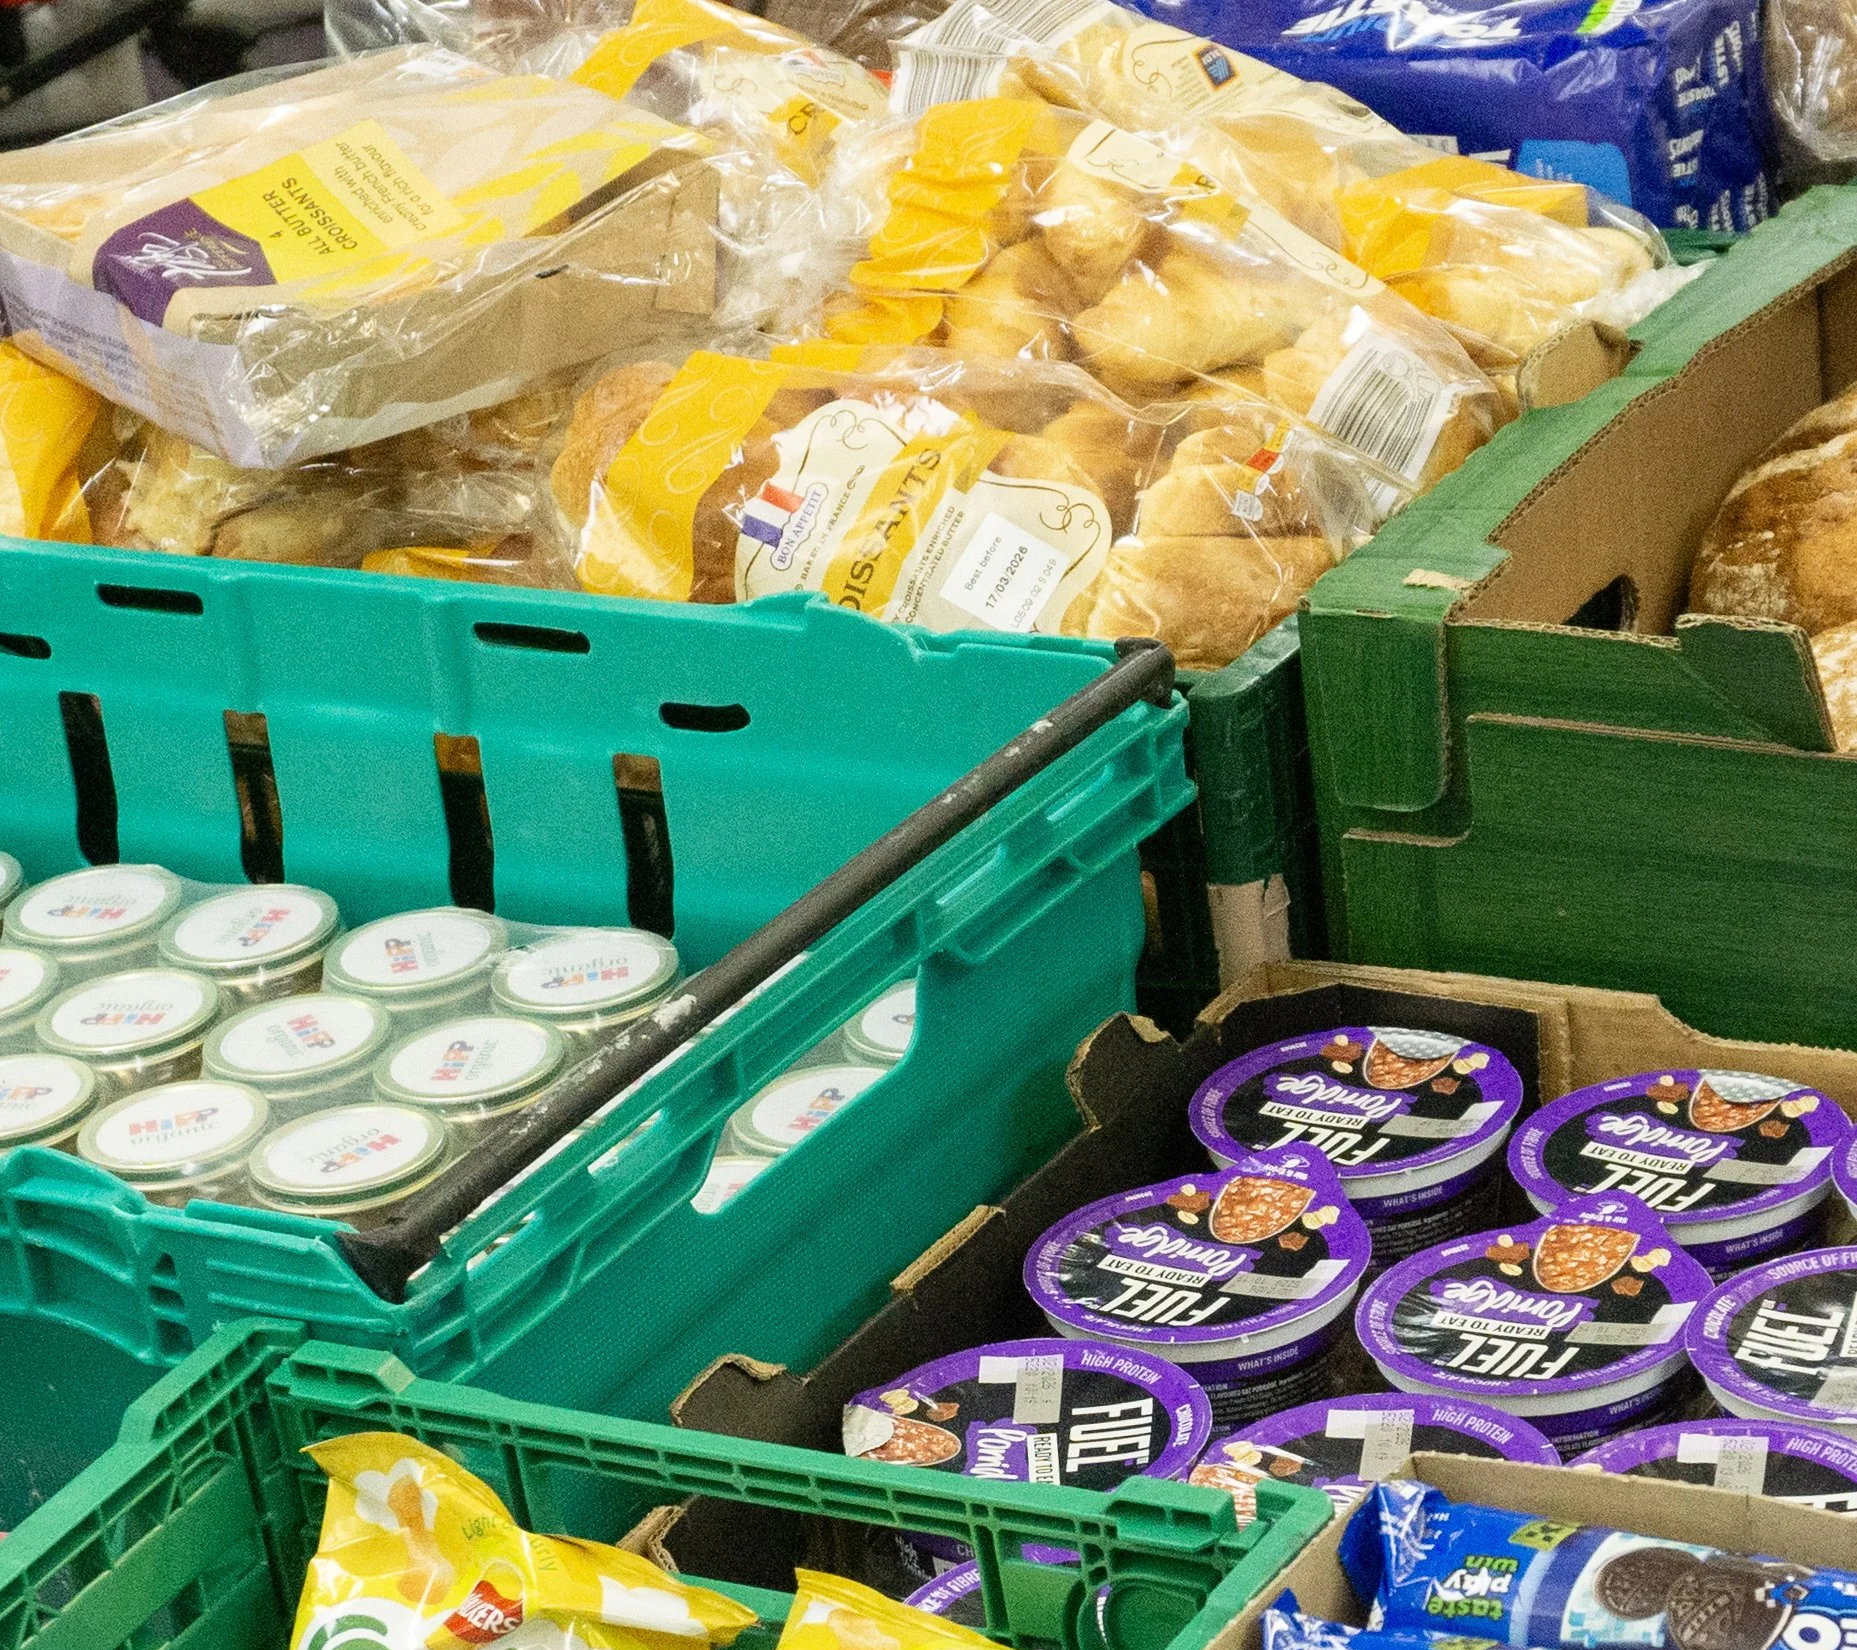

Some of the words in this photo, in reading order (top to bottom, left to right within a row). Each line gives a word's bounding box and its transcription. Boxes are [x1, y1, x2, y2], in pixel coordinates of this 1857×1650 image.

[335, 142, 368, 172] butter
[361, 143, 397, 179] flavour
[334, 165, 357, 189] with
[362, 169, 397, 205] French
[393, 176, 414, 196] rich
[261, 189, 314, 234] BUTTER
[281, 176, 359, 250] CROISSANTS
[351, 186, 393, 223] enriched
[410, 194, 422, 204] a
[390, 201, 427, 232] creamy
[268, 228, 286, 240] 4
[304, 232, 335, 256] ALL
[800, 544, 821, 582] BAKED
[827, 490, 850, 534] FRANCE
[837, 446, 942, 611] OISSANTS
[926, 505, 956, 555] ENRICHED
[777, 538, 796, 565] BON
[964, 567, 984, 592] Best
[978, 535, 1003, 570] before
[905, 546, 946, 625] CONCENTRATED
[943, 510, 965, 548] BUTTER
[984, 544, 1029, 610] 17/03/2026
[1266, 1102, 1294, 1117] EAT
[1275, 1073, 1403, 1120] Porridge
[1294, 1108, 1314, 1120] TO
[1316, 1111, 1364, 1128] READY
[1588, 1144, 1616, 1161] EAT
[1598, 1113, 1730, 1164] Porridge
[1617, 1152, 1639, 1165] TO
[1641, 1156, 1688, 1173] READY
[1382, 1191, 1418, 1208] WHAT'S
[1417, 1185, 1444, 1201] INSIDE
[1116, 1225, 1248, 1278] Porridge
[1725, 1235, 1759, 1254] WHAT'S
[1759, 1228, 1784, 1245] INSIDE
[1105, 1257, 1134, 1274] EAT
[1134, 1265, 1155, 1279] TO
[1157, 1269, 1206, 1287] READY
[1768, 1256, 1820, 1281] SOURCE
[1821, 1253, 1840, 1267] OF
[1108, 1276, 1232, 1327] FUEL
[1443, 1279, 1583, 1328] Porridge
[1439, 1312, 1469, 1327] EAT
[1471, 1318, 1494, 1331] TO
[1498, 1320, 1546, 1338] READY
[1734, 1304, 1846, 1377] FUEL
[1080, 1349, 1110, 1368] HIGH
[1109, 1357, 1162, 1386] PROTEIN
[1237, 1355, 1273, 1372] WHAT'S
[1273, 1345, 1300, 1365] INSIDE
[1447, 1332, 1580, 1380] FUEL
[1608, 1398, 1644, 1415] WHAT'S
[1065, 1397, 1154, 1473] FUEL
[1172, 1403, 1192, 1448] CHOCOLATE
[1431, 1408, 1464, 1428] HIGH
[1464, 1414, 1516, 1445] PROTEIN
[969, 1428, 1028, 1480] Porrid
[1033, 1436, 1052, 1464] READY
[1786, 1437, 1823, 1460] HIGH
[1823, 1442, 1857, 1473] PROTE
[1034, 1464, 1054, 1478] TO
[460, 1514, 497, 1541] Light
[529, 1537, 559, 1574] urly
[1464, 1554, 1519, 1576] win
[946, 1567, 981, 1594] FIBRE
[1442, 1568, 1513, 1602] play
[1426, 1597, 1504, 1621] taste
